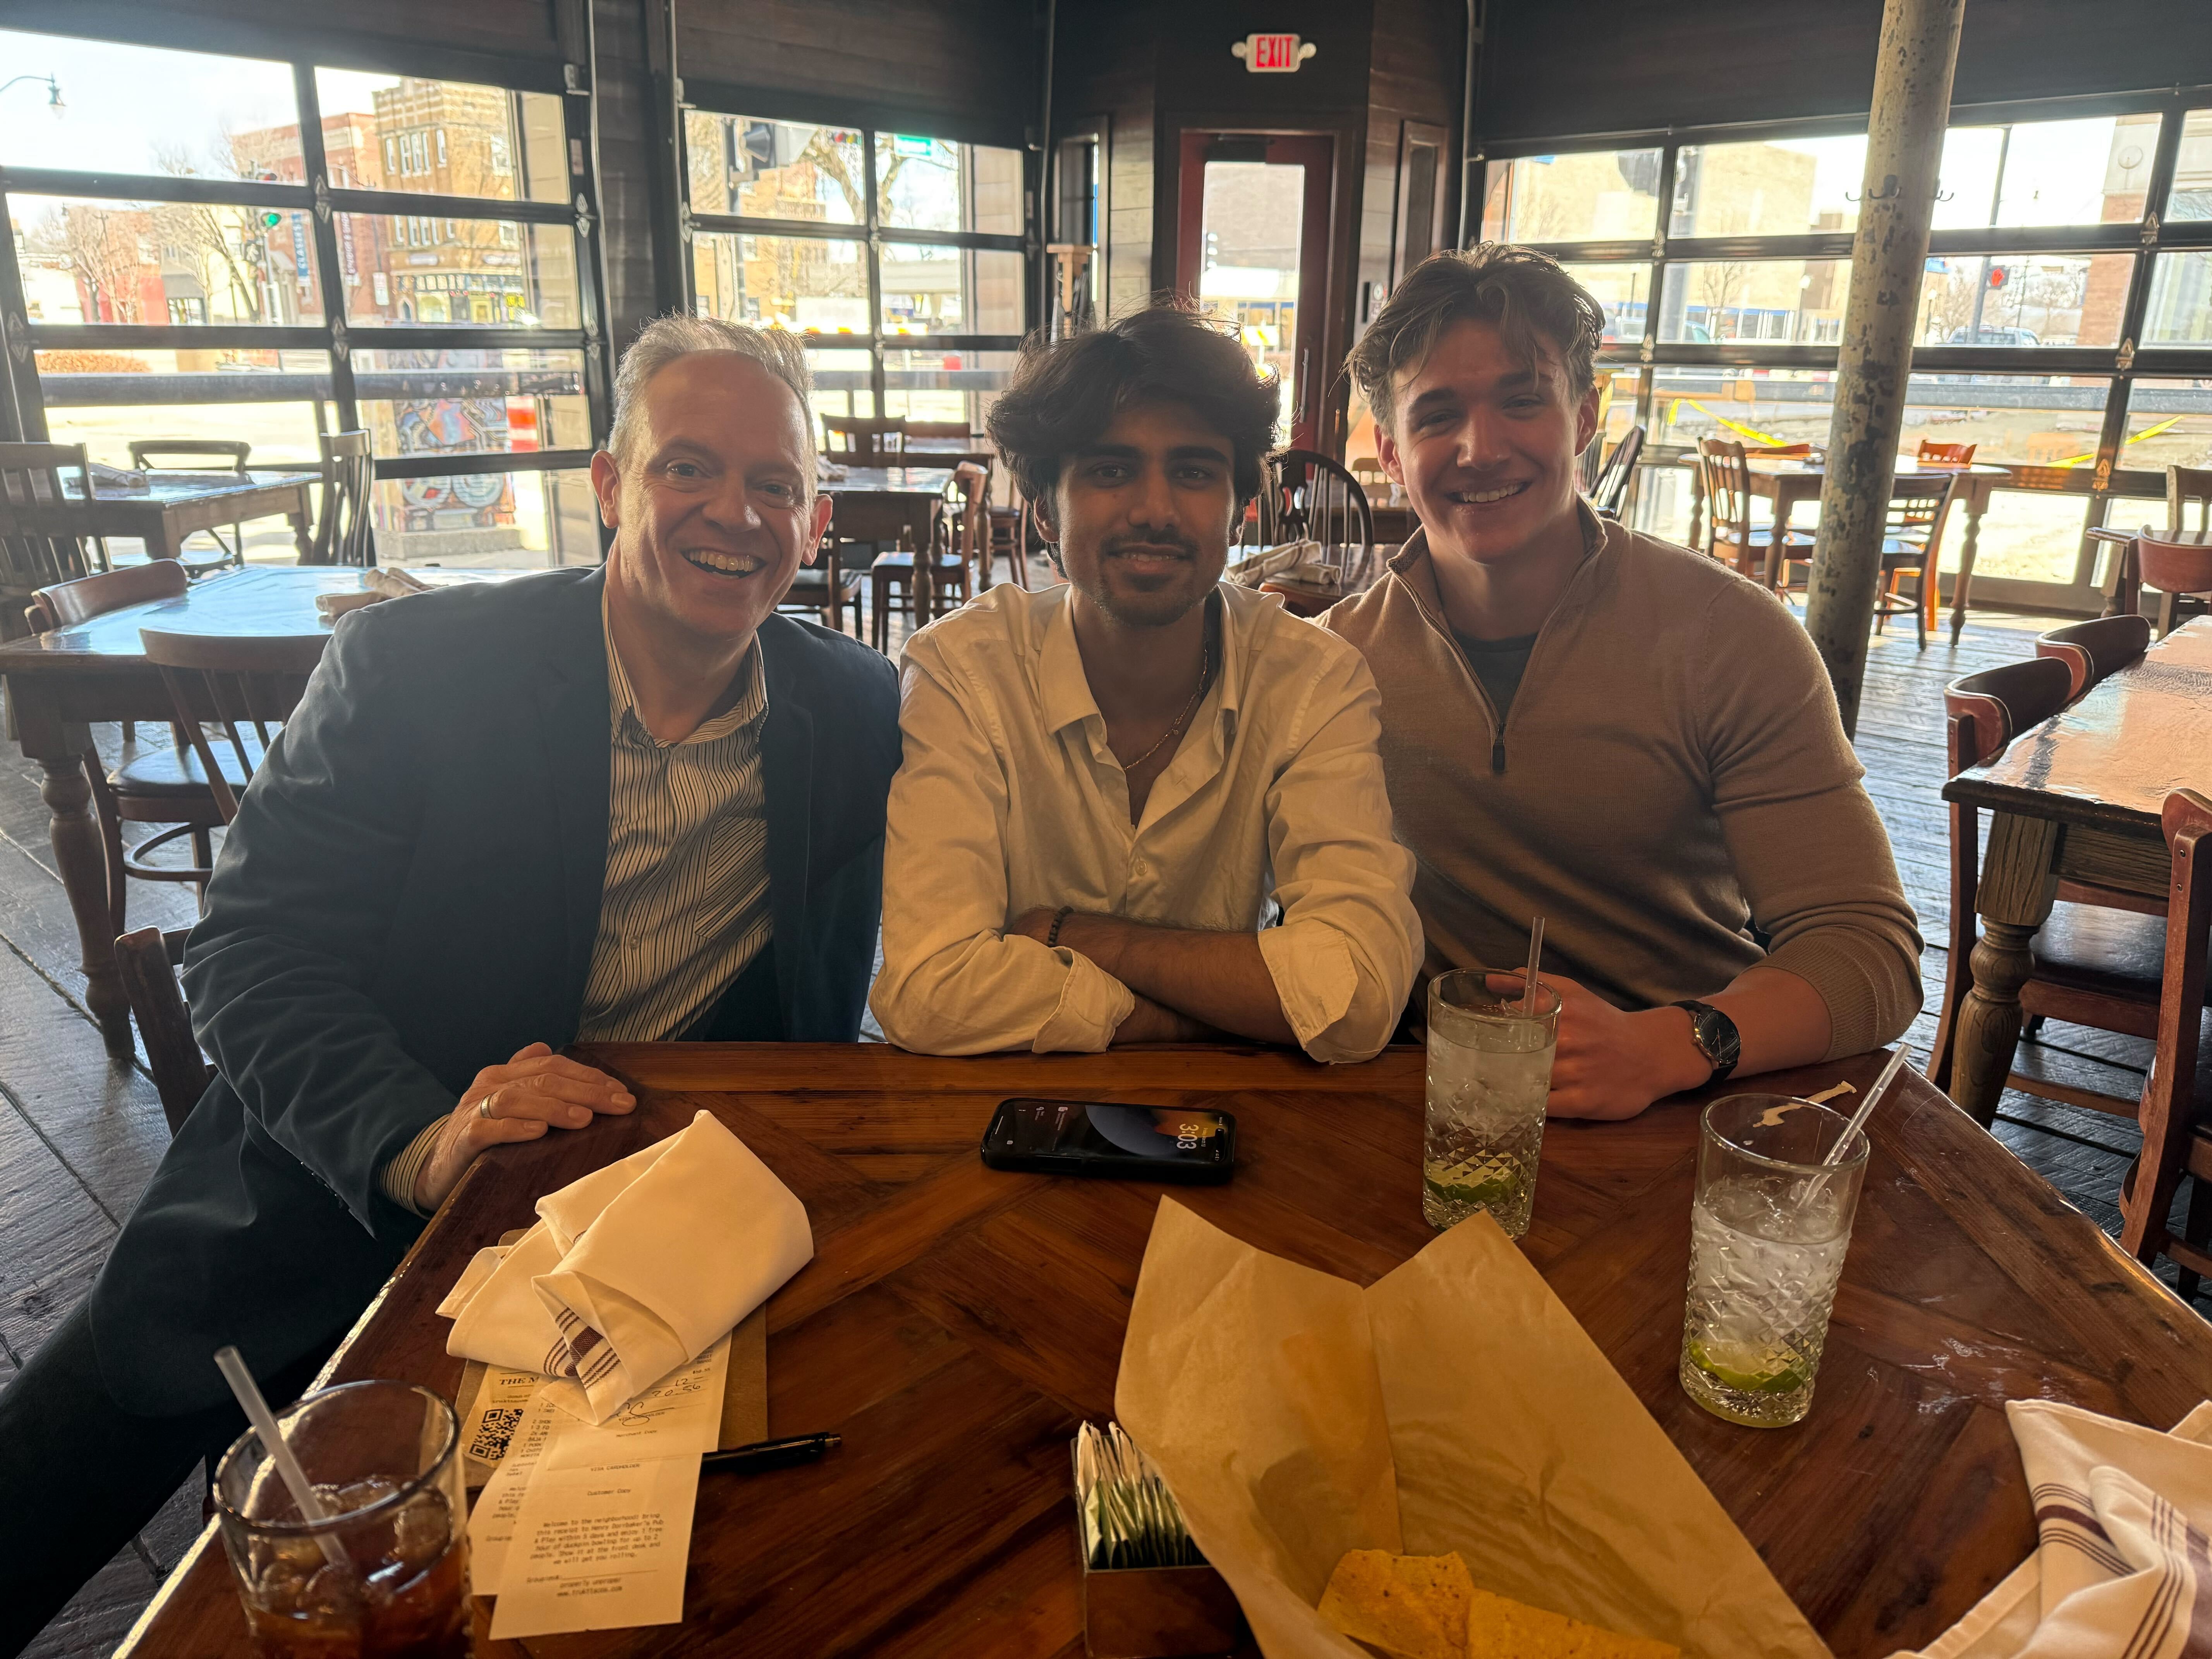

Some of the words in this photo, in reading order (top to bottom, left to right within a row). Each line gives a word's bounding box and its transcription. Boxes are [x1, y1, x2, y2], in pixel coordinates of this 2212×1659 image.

[1256, 37, 1293, 67] EXIT
[294, 224, 306, 269] CLASSES
[1176, 1123, 1199, 1150] 3:03
